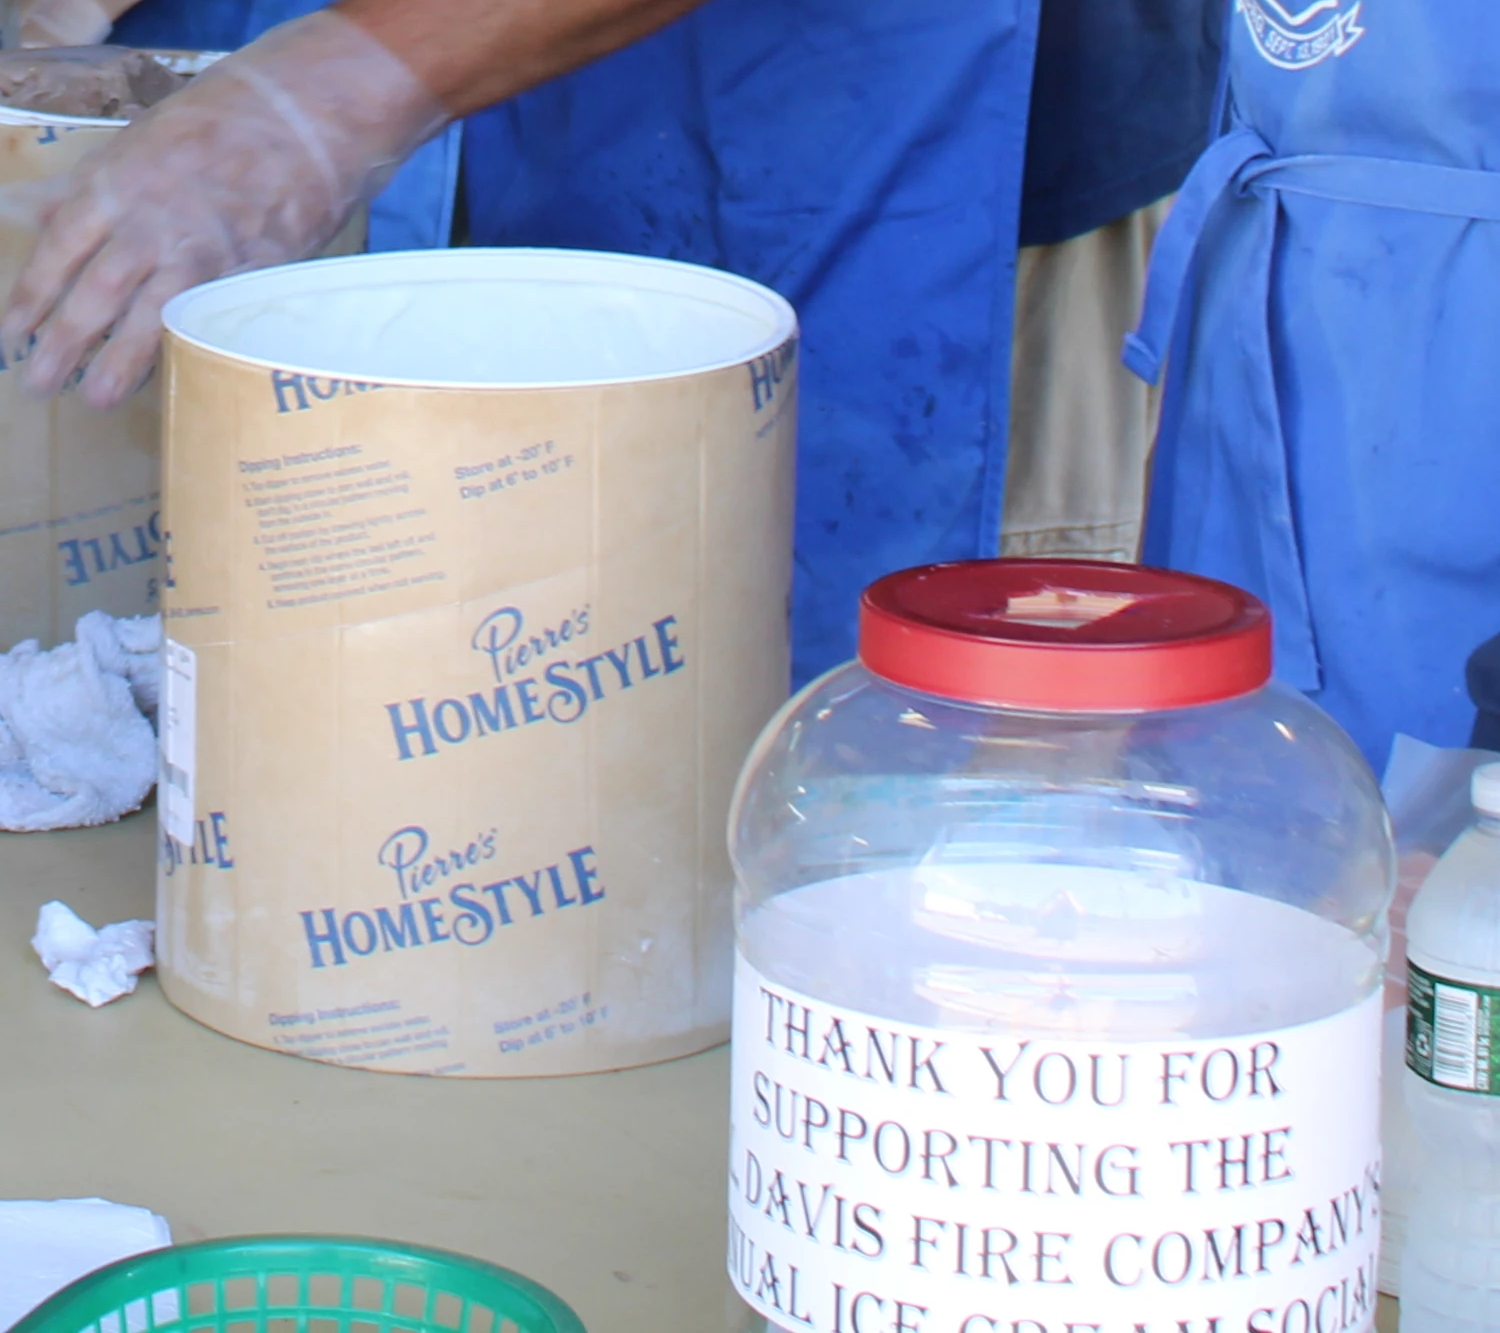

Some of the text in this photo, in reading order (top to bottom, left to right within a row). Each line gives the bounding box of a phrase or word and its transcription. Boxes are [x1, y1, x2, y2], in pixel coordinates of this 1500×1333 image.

[454, 461, 494, 480] Store
[497, 454, 513, 468] at
[459, 485, 485, 500] Dip
[489, 478, 504, 492] at
[521, 469, 538, 481] to
[471, 605, 590, 683] Pierre's
[377, 826, 498, 900] Pierre's
[494, 1016, 533, 1034] Store
[536, 1009, 551, 1023] at
[499, 1039, 525, 1053] Dip
[527, 1032, 542, 1045] at
[560, 1022, 575, 1033] to
[759, 986, 1286, 1107] THANK YOU FOR
[753, 1070, 1295, 1197] SUPPORTING THE
[745, 1149, 885, 1258] DAVIS
[909, 1214, 1074, 1286] FIRE
